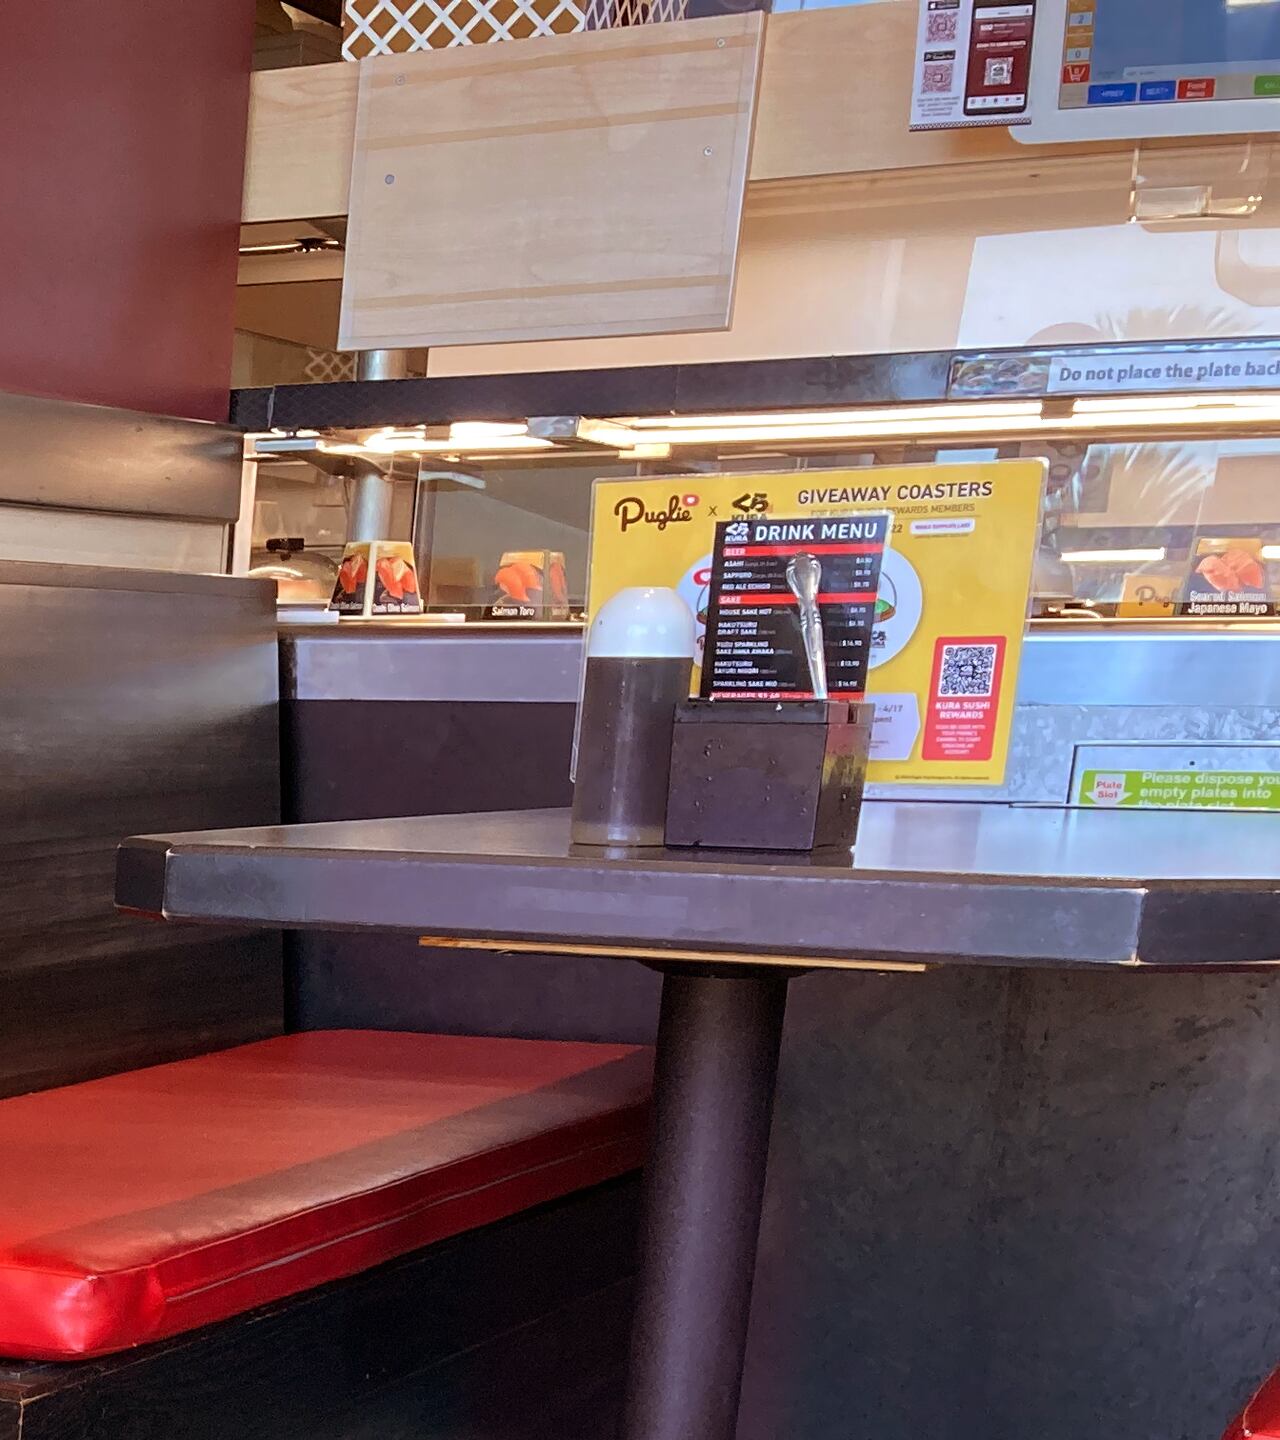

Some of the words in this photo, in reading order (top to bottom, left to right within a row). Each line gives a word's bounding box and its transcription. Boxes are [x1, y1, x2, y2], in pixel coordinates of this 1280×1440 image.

[1059, 366, 1082, 382] Do
[1085, 366, 1113, 381] not
[1117, 363, 1162, 384] place
[1165, 362, 1193, 378] the
[1196, 360, 1241, 381] plate
[798, 486, 891, 505] GIVEAWAY
[898, 481, 993, 500] COASTERS
[614, 495, 693, 532] Puglie
[931, 503, 975, 512] MEMBERS
[755, 525, 815, 541] DRINK
[821, 522, 878, 540] MENU
[724, 547, 746, 556] BEER
[491, 606, 518, 616] Salmon
[518, 606, 535, 616] Toro
[1188, 601, 1236, 615] Japanese
[1239, 602, 1268, 615] Mayo
[935, 701, 961, 710] KURA
[963, 701, 990, 710] SUSHI
[940, 711, 984, 719] REWARDS
[1095, 780, 1122, 790] Plate
[1141, 771, 1191, 784] Please
[1195, 772, 1253, 788] dispose
[1097, 790, 1118, 799] Slot
[1140, 786, 1188, 802] empty
[1191, 786, 1238, 801] plates
[1242, 787, 1272, 799] into
